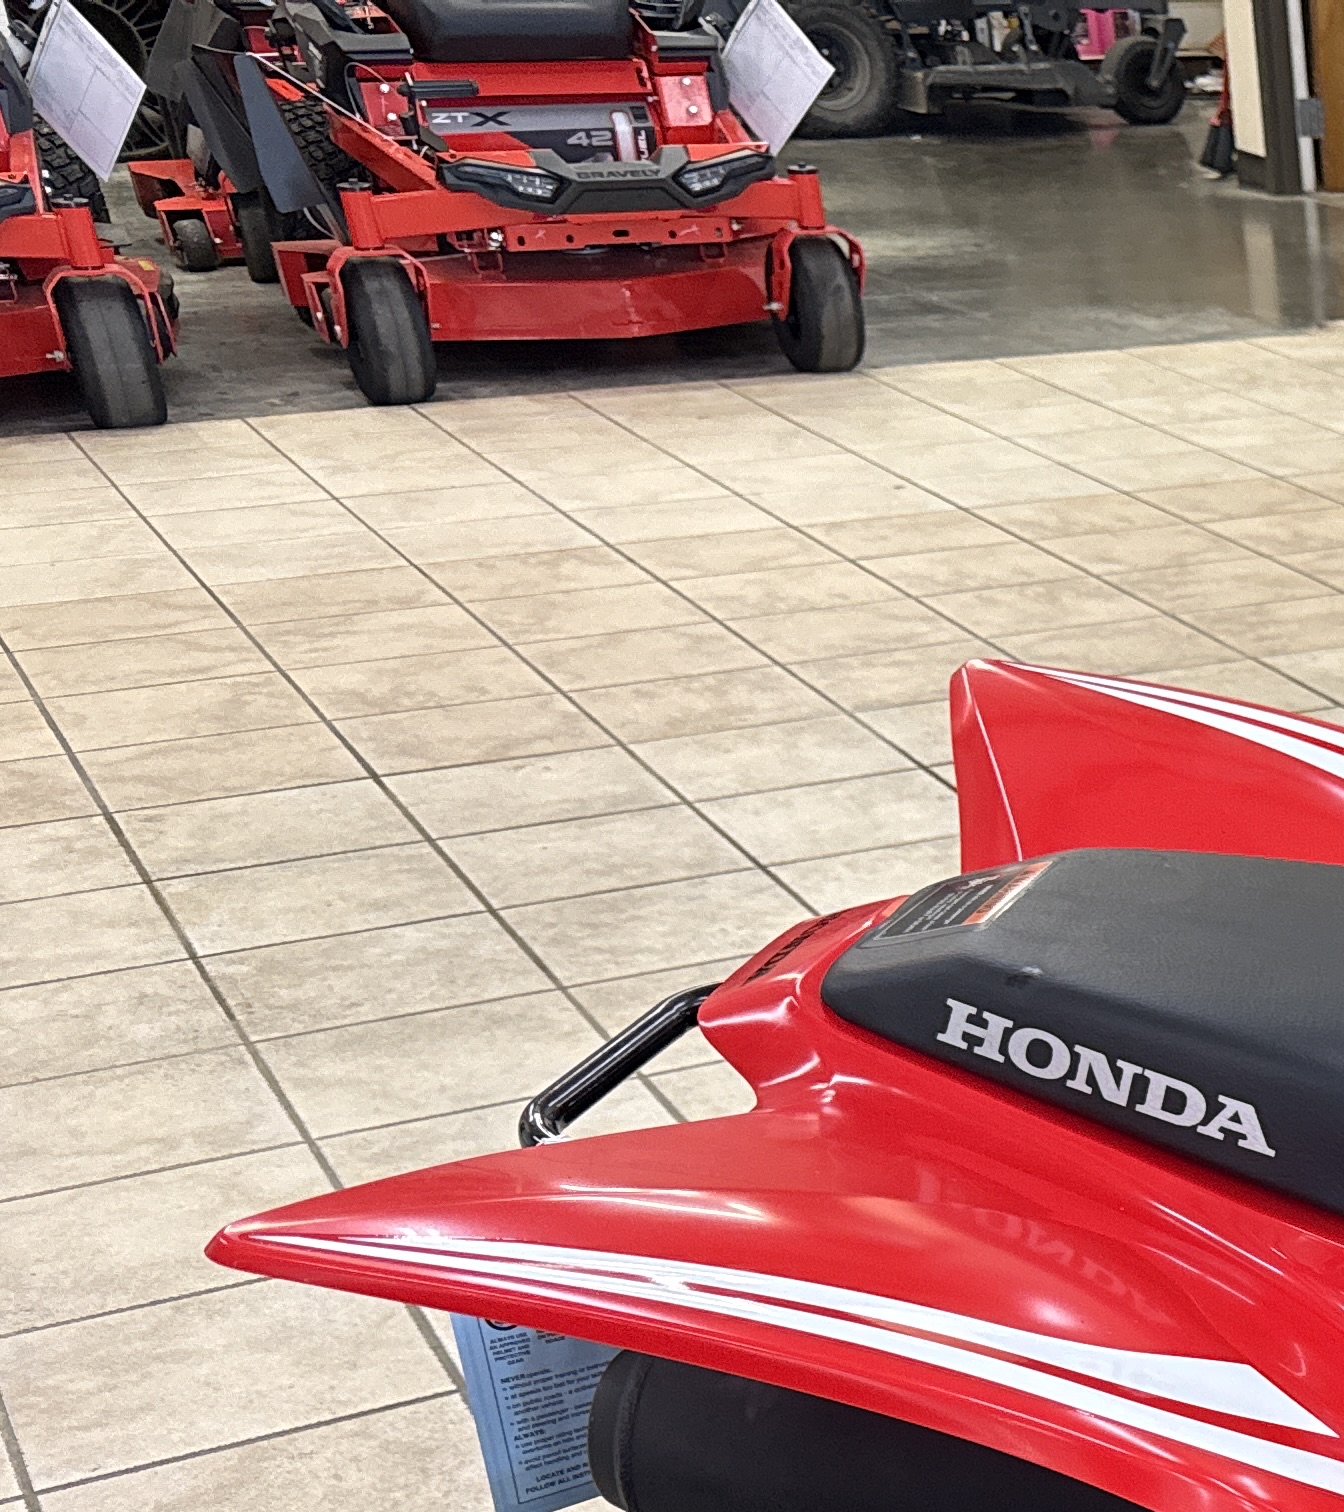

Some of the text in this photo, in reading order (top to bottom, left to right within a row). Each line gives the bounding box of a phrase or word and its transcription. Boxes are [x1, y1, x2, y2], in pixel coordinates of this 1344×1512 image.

[566, 130, 614, 147] 42
[637, 129, 649, 160] UEL
[576, 167, 661, 180] GRAVELY
[936, 998, 1276, 1158] HONDA
[536, 1469, 565, 1482] LOCATE
[526, 1481, 556, 1494] FOLLOW
